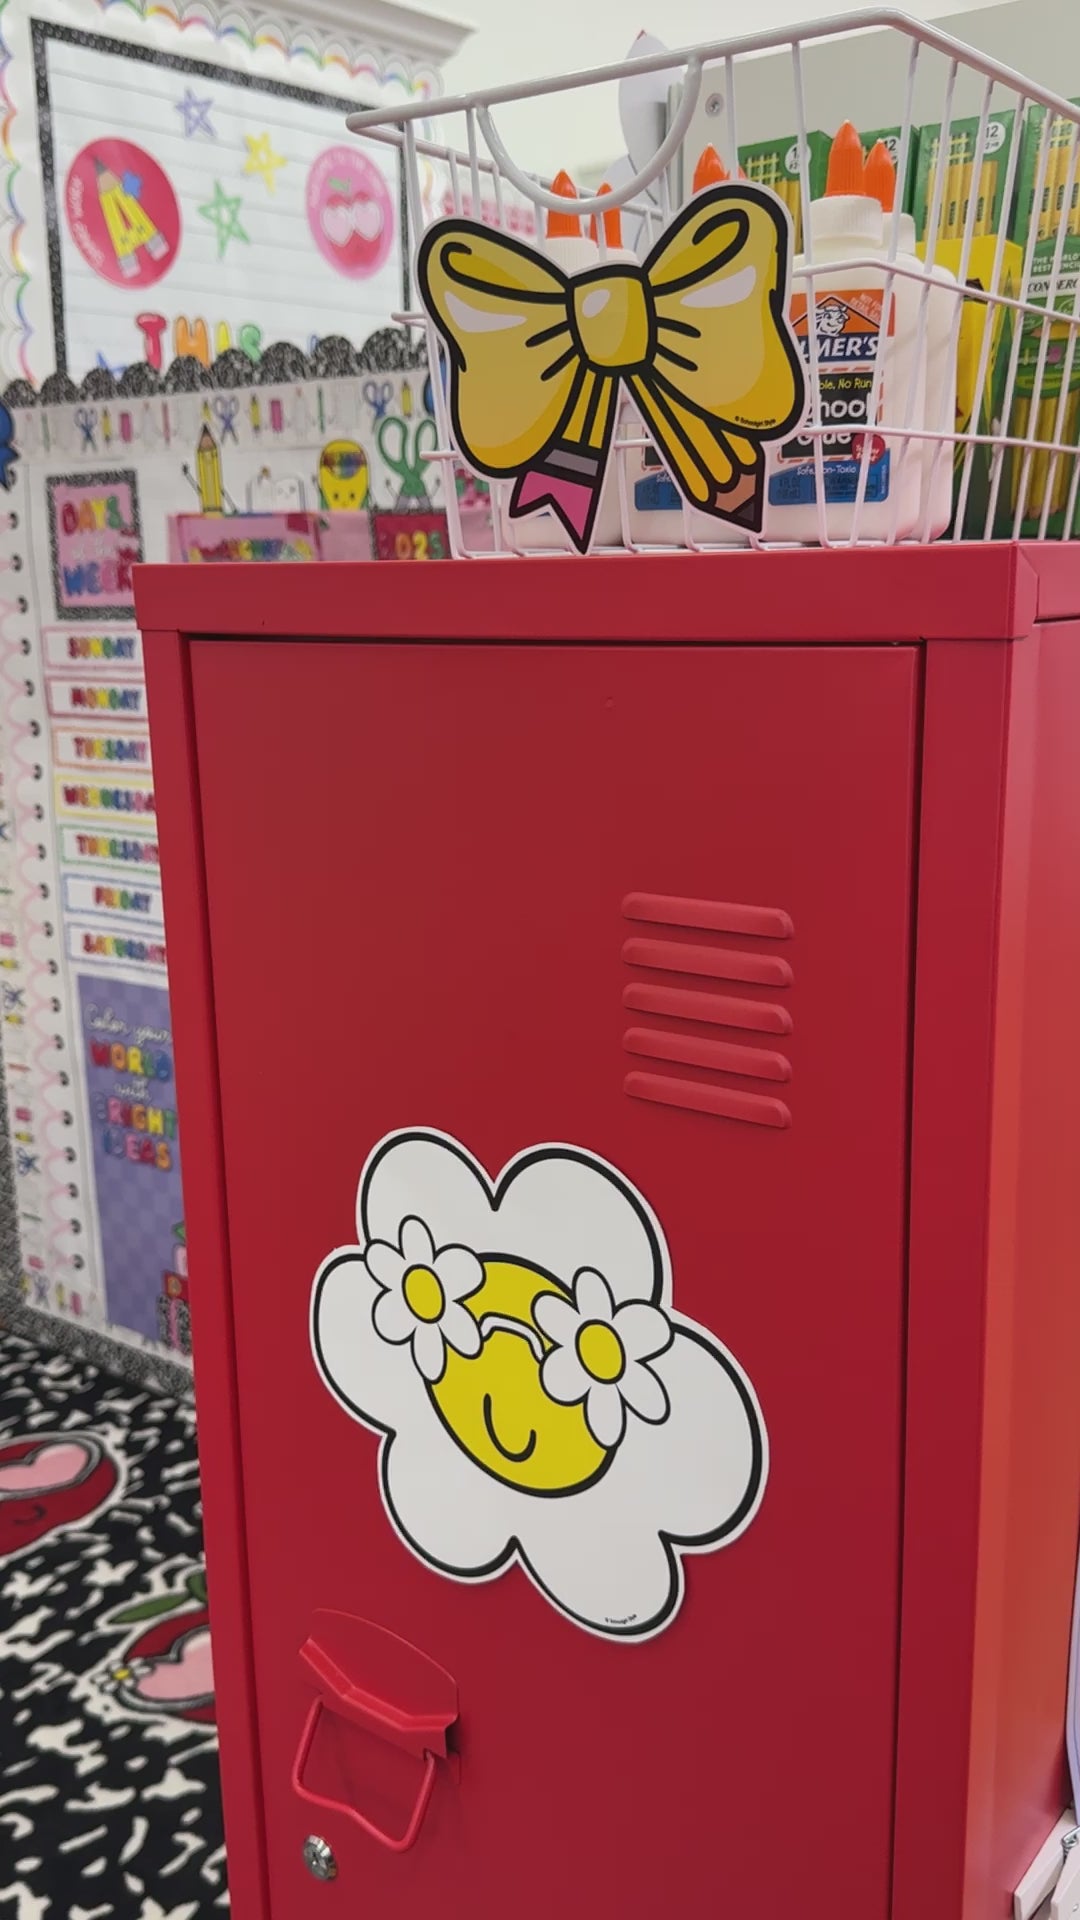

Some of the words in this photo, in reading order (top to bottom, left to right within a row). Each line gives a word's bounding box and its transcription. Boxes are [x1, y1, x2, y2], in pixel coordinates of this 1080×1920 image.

[984, 125, 999, 138] 12
[136, 312, 262, 373] THIS
[799, 336, 880, 357] LMER'S
[838, 378, 851, 389] No
[822, 464, 857, 474] on-Toxic
[61, 495, 123, 537] DAYS
[62, 562, 134, 597] WEEK
[67, 635, 136, 660] SUNDAY
[70, 686, 140, 712] MONDAY
[74, 736, 147, 763] TUESDAY
[63, 785, 156, 814] WEDNESDA
[95, 886, 152, 914] FRIDAY
[89, 1037, 172, 1082] WORLD
[91, 1092, 177, 1141] BRIGHT
[102, 1128, 172, 1173] IDEAS
